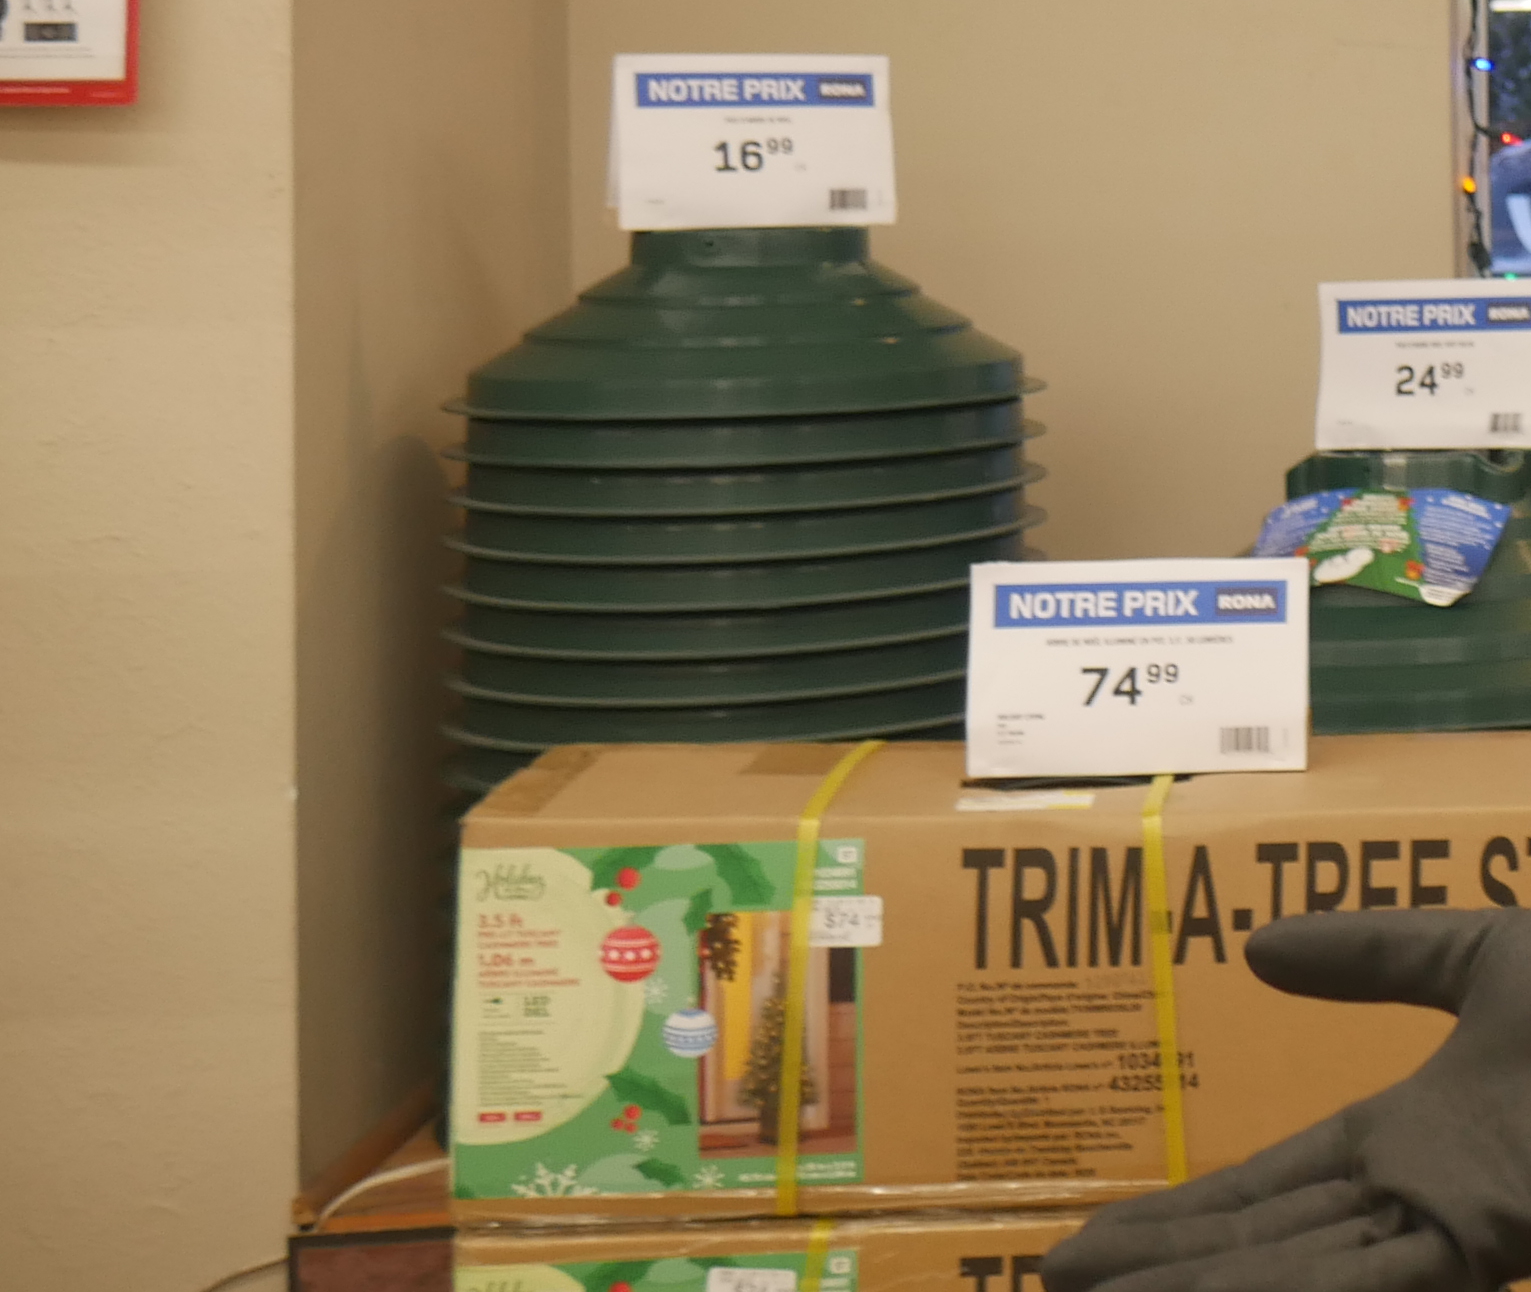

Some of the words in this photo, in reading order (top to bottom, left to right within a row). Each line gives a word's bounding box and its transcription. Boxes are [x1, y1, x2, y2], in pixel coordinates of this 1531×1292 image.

[648, 78, 740, 102] NOTRE
[742, 78, 806, 102] PRIX
[1346, 305, 1421, 329] NOTRE
[1422, 303, 1477, 327] PRIX
[1008, 589, 1119, 620] NOTRE
[1122, 588, 1199, 618] PRIX
[1216, 593, 1277, 611] RONA
[1117, 1051, 1195, 1071] 103491
[1109, 1073, 1200, 1092] 4325514
